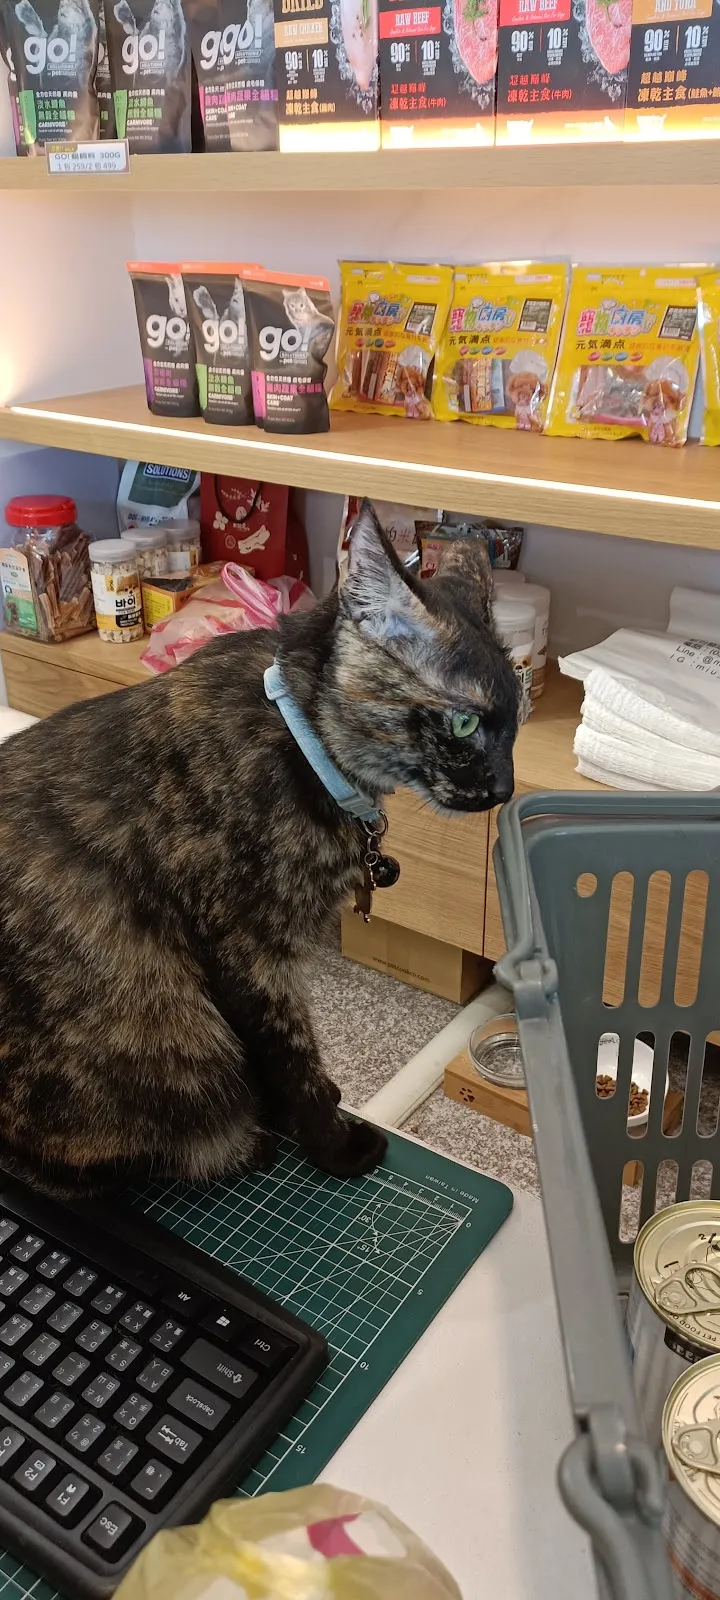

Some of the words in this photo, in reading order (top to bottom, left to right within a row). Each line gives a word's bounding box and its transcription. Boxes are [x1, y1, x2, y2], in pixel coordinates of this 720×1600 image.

[519, 0, 536, 12] RAW
[539, 0, 558, 11] BEEF
[655, 0, 672, 13] AND
[674, 0, 697, 11] TUNA
[395, 13, 412, 26] RAW
[413, 11, 430, 25] BEEF
[507, 87, 572, 103] 凍乾主食(牛肉)
[100, 151, 121, 159] 300G
[146, 463, 189, 479] SOLUTIONS
[676, 645, 695, 657] Line
[425, 1174, 448, 1190] Taiwan
[459, 1190, 480, 1204] Made
[6, 1285, 14, 1293] H
[177, 1291, 191, 1301] Alt
[32, 1303, 40, 1311] G
[133, 1322, 141, 1330] X
[680, 1319, 700, 1334] FOOD
[702, 1332, 717, 1342] PET
[164, 1340, 173, 1348] Z
[254, 1338, 271, 1352] Ctrl
[216, 1363, 234, 1377] Shift
[360, 1361, 370, 1371] 10
[66, 1374, 75, 1382] E
[94, 1394, 104, 1403] W
[62, 1403, 70, 1411] 3
[185, 1394, 215, 1416] CapsLock
[129, 1417, 137, 1425] Q
[92, 1424, 100, 1432] 2
[80, 1437, 90, 1447] @
[174, 1437, 189, 1451] Tab
[295, 1443, 307, 1454] 15
[24, 1466, 39, 1481] F2
[57, 1492, 71, 1505] F1
[100, 1516, 119, 1536] Esc
